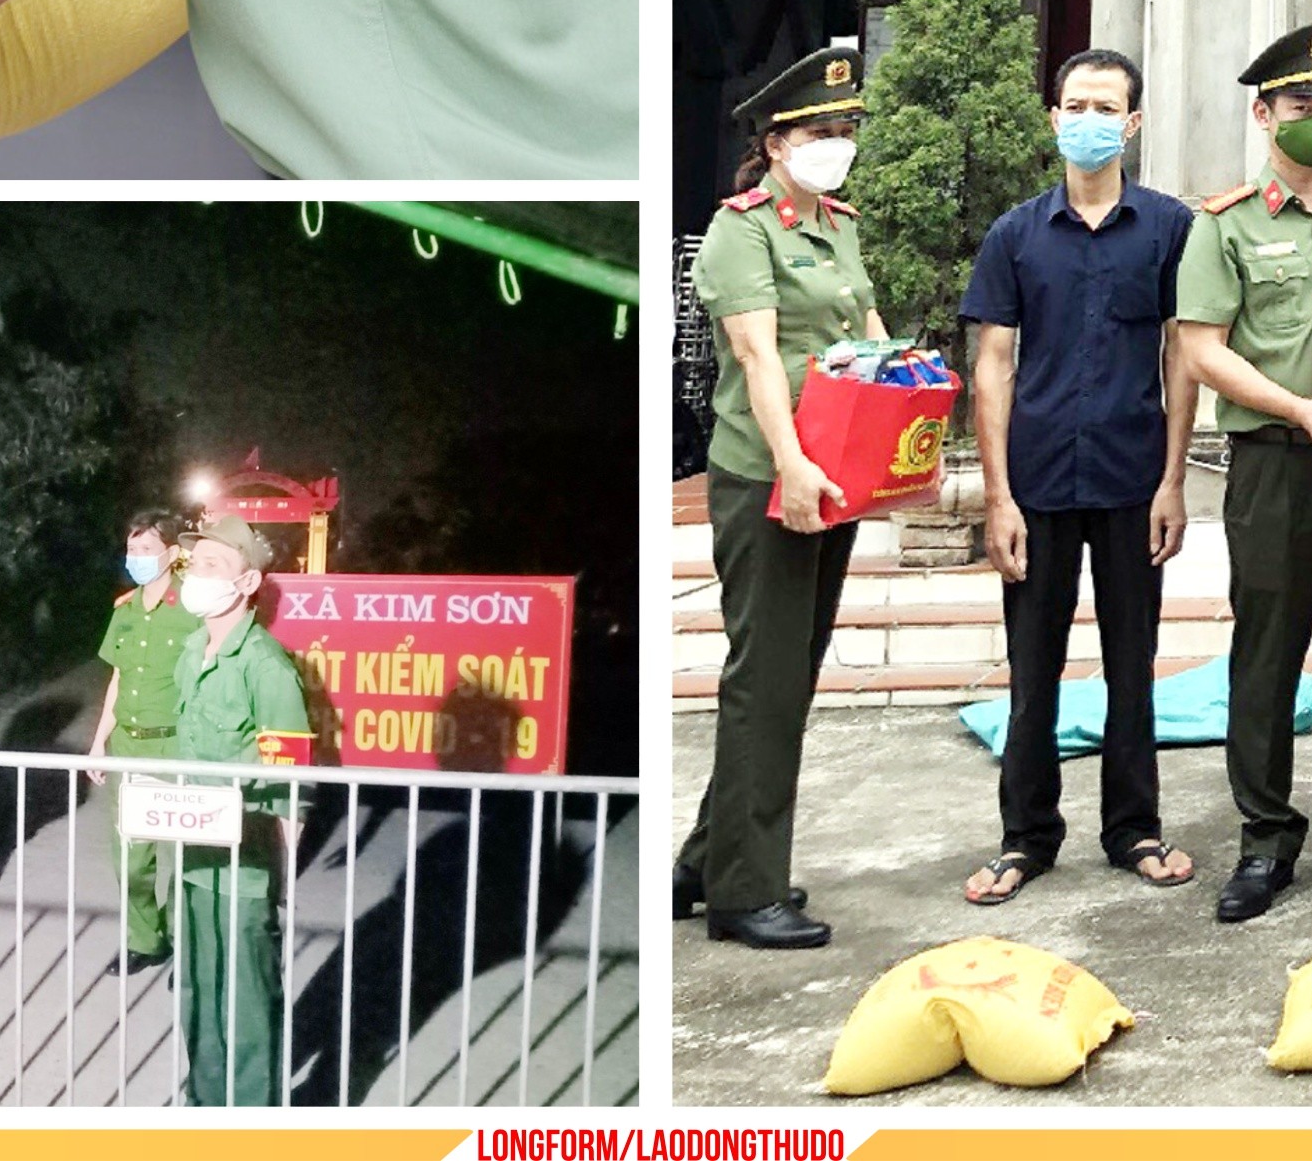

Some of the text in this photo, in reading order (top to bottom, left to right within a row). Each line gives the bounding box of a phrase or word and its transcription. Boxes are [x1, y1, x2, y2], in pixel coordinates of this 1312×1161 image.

[284, 587, 533, 624] XÃ KIM SƠN
[292, 635, 551, 701] ỐT KIỂM SOÁT
[354, 708, 457, 755] COVID
[497, 715, 538, 760] 19
[153, 792, 206, 805] POLICE
[146, 810, 216, 829] STOP
